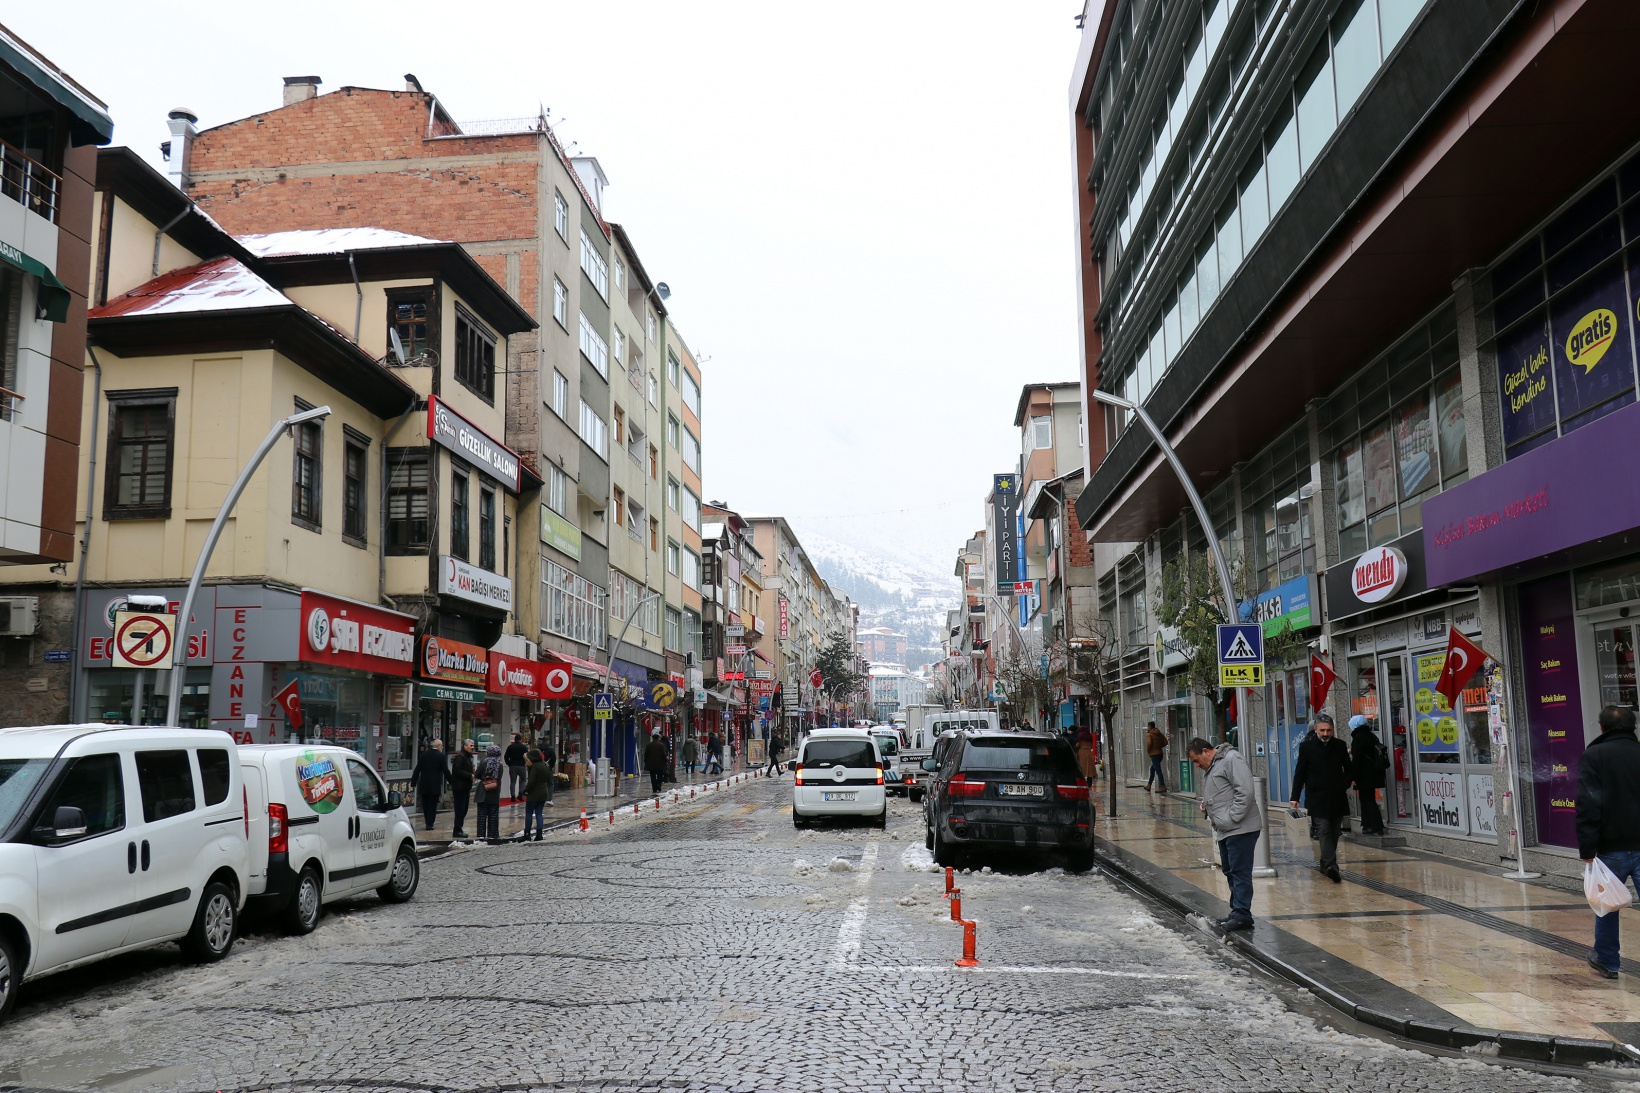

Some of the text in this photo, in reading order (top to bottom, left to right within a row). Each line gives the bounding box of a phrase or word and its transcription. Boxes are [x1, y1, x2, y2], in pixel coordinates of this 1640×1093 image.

[1571, 312, 1611, 360] gratis
[1530, 345, 1548, 374] bak
[459, 427, 517, 481] GÜZELLİK SALONU
[1001, 495, 1009, 528] İYİ
[1002, 532, 1011, 580] PARTİ
[1355, 549, 1394, 594] mendy
[458, 575, 470, 591] KAN
[471, 578, 489, 599] BAĞIŞI
[489, 584, 510, 603] MERKEZİ
[1257, 595, 1282, 622] aksa
[331, 610, 415, 663] ŞİFA ECZANESİ
[1427, 620, 1441, 633] NBB
[230, 610, 246, 717] ECZANE
[438, 648, 464, 670] Marka
[465, 654, 489, 675] Döner
[1225, 667, 1247, 676] İLK
[507, 667, 533, 686] vodafone
[455, 691, 473, 700] USTAM
[1463, 686, 1487, 704] men
[1003, 785, 1013, 793] 29
[1028, 786, 1043, 794] 900
[1424, 776, 1456, 800] ORKİDE
[1423, 804, 1442, 825] Yeni
